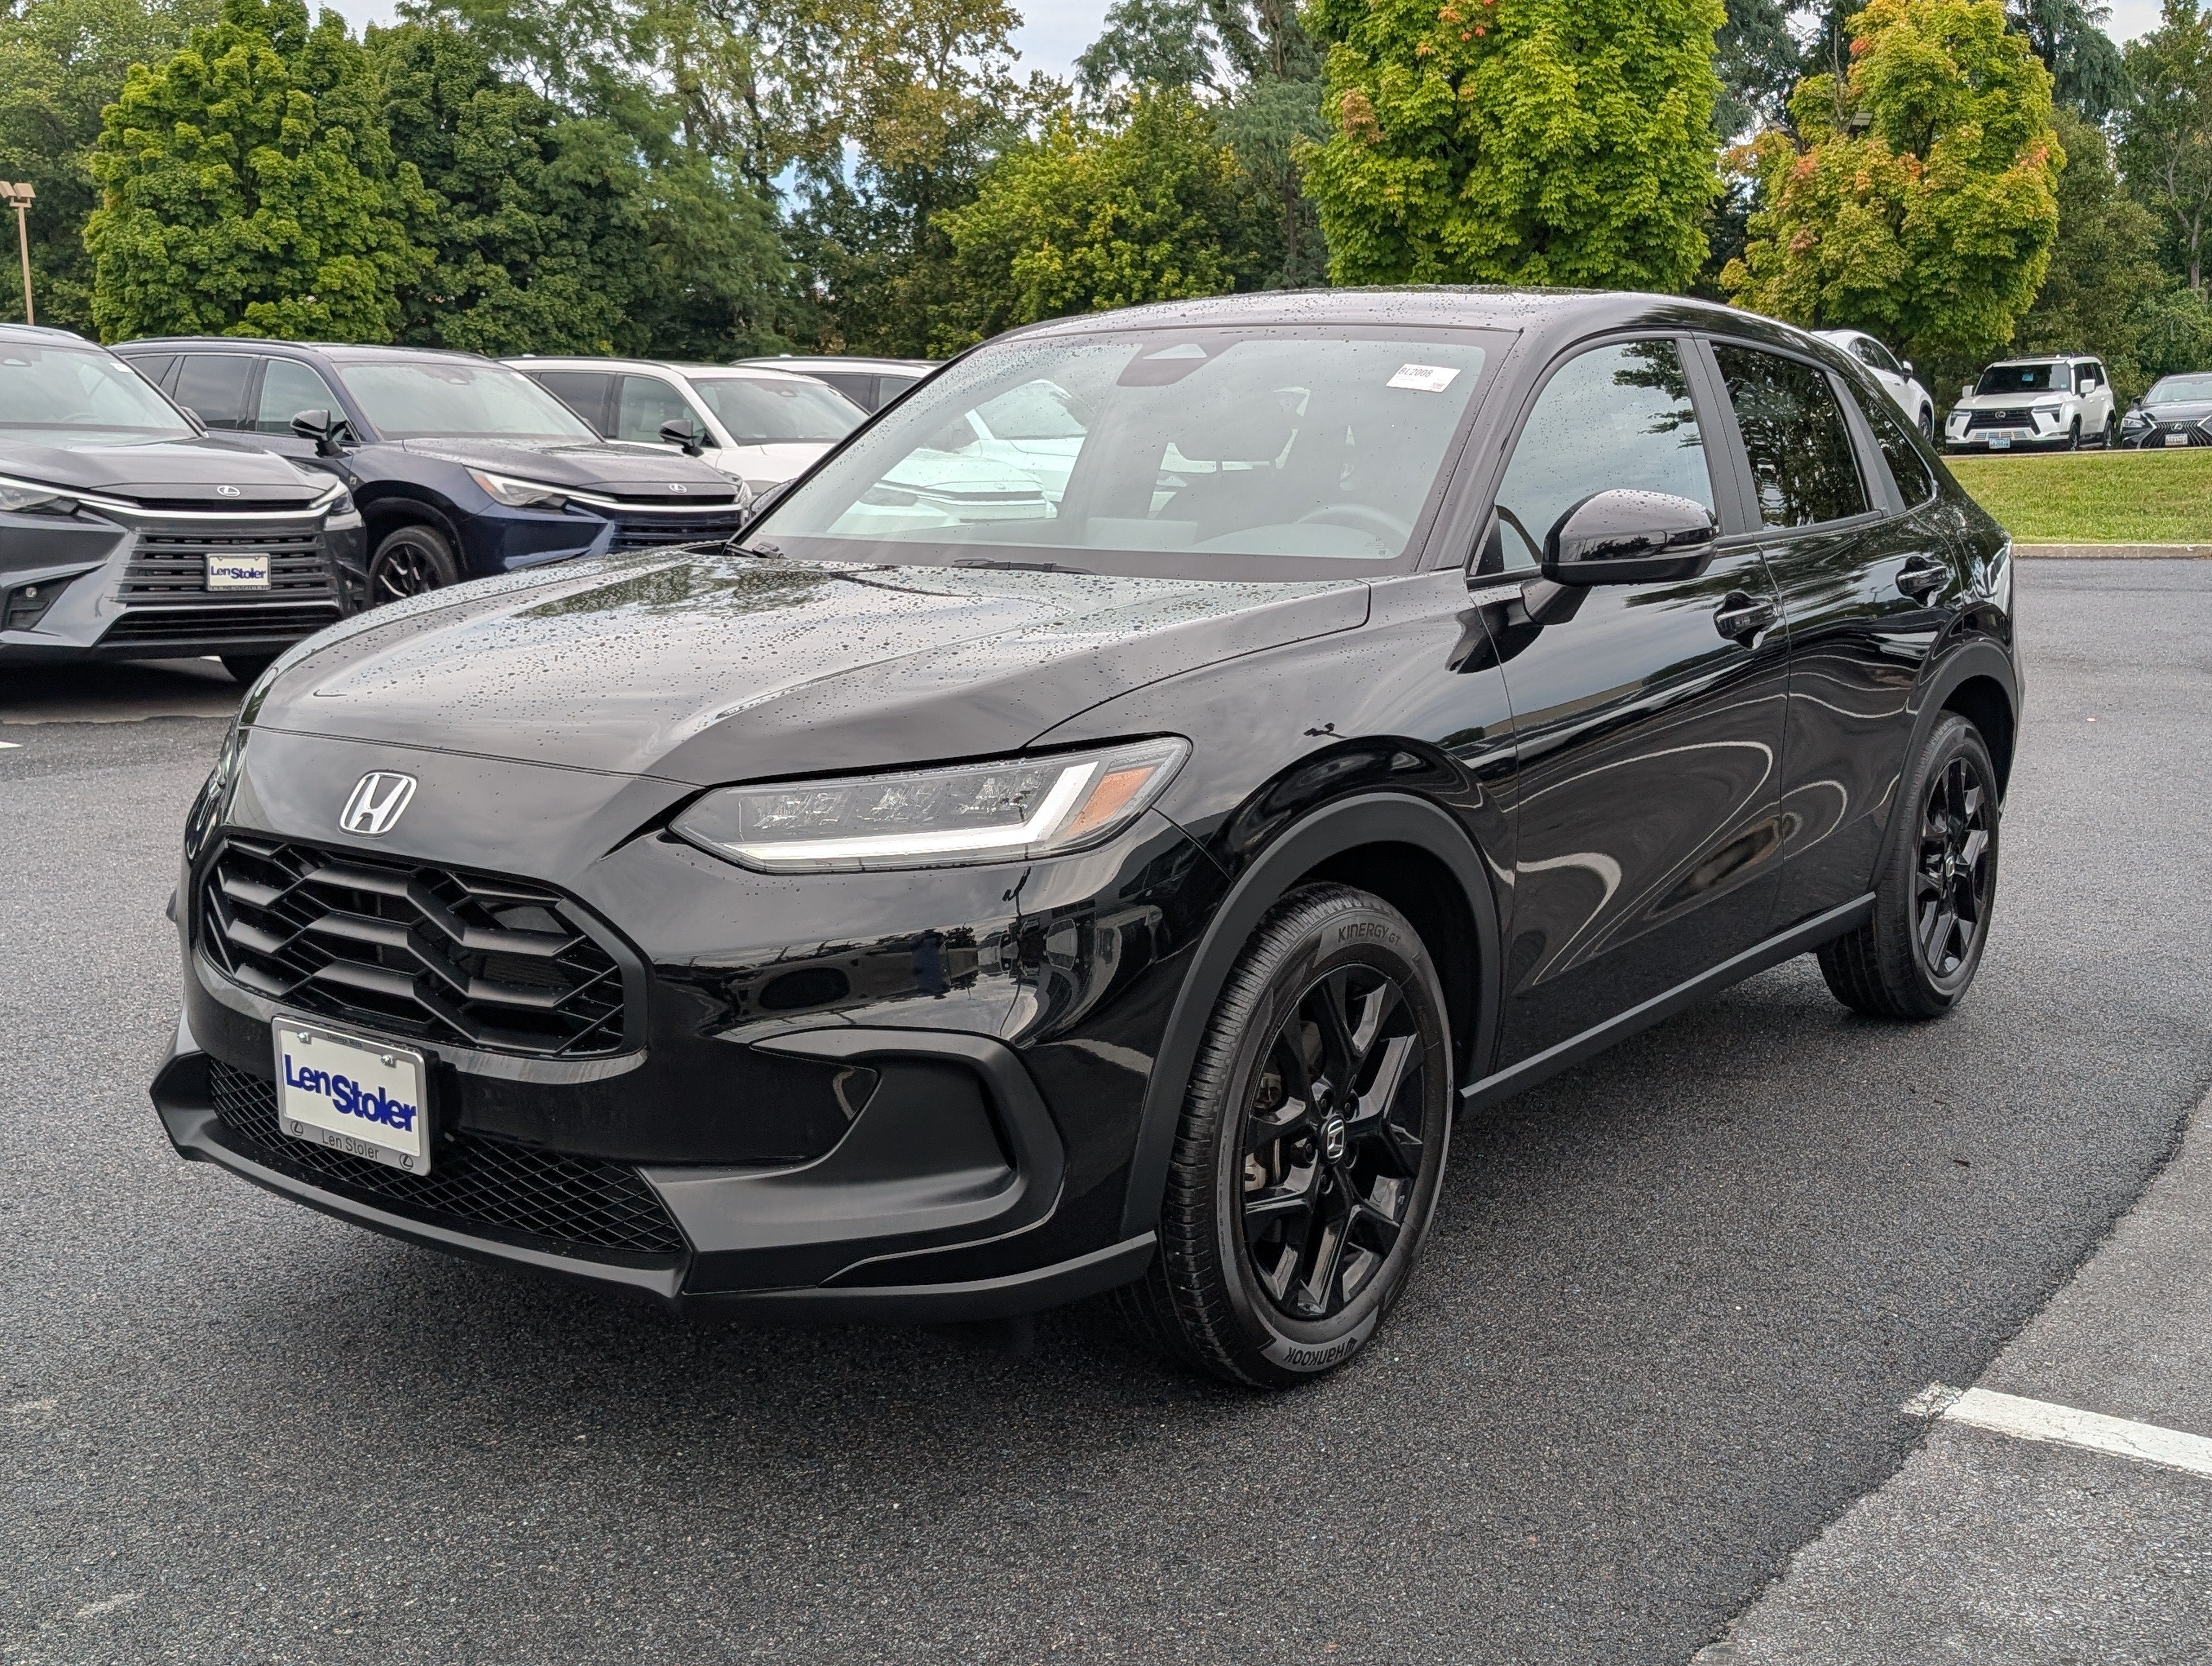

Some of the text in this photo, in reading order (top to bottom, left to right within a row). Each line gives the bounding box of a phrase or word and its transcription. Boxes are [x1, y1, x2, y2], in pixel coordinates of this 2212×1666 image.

[1388, 932, 1401, 946] GT
[322, 1130, 379, 1159] Len Stoler
